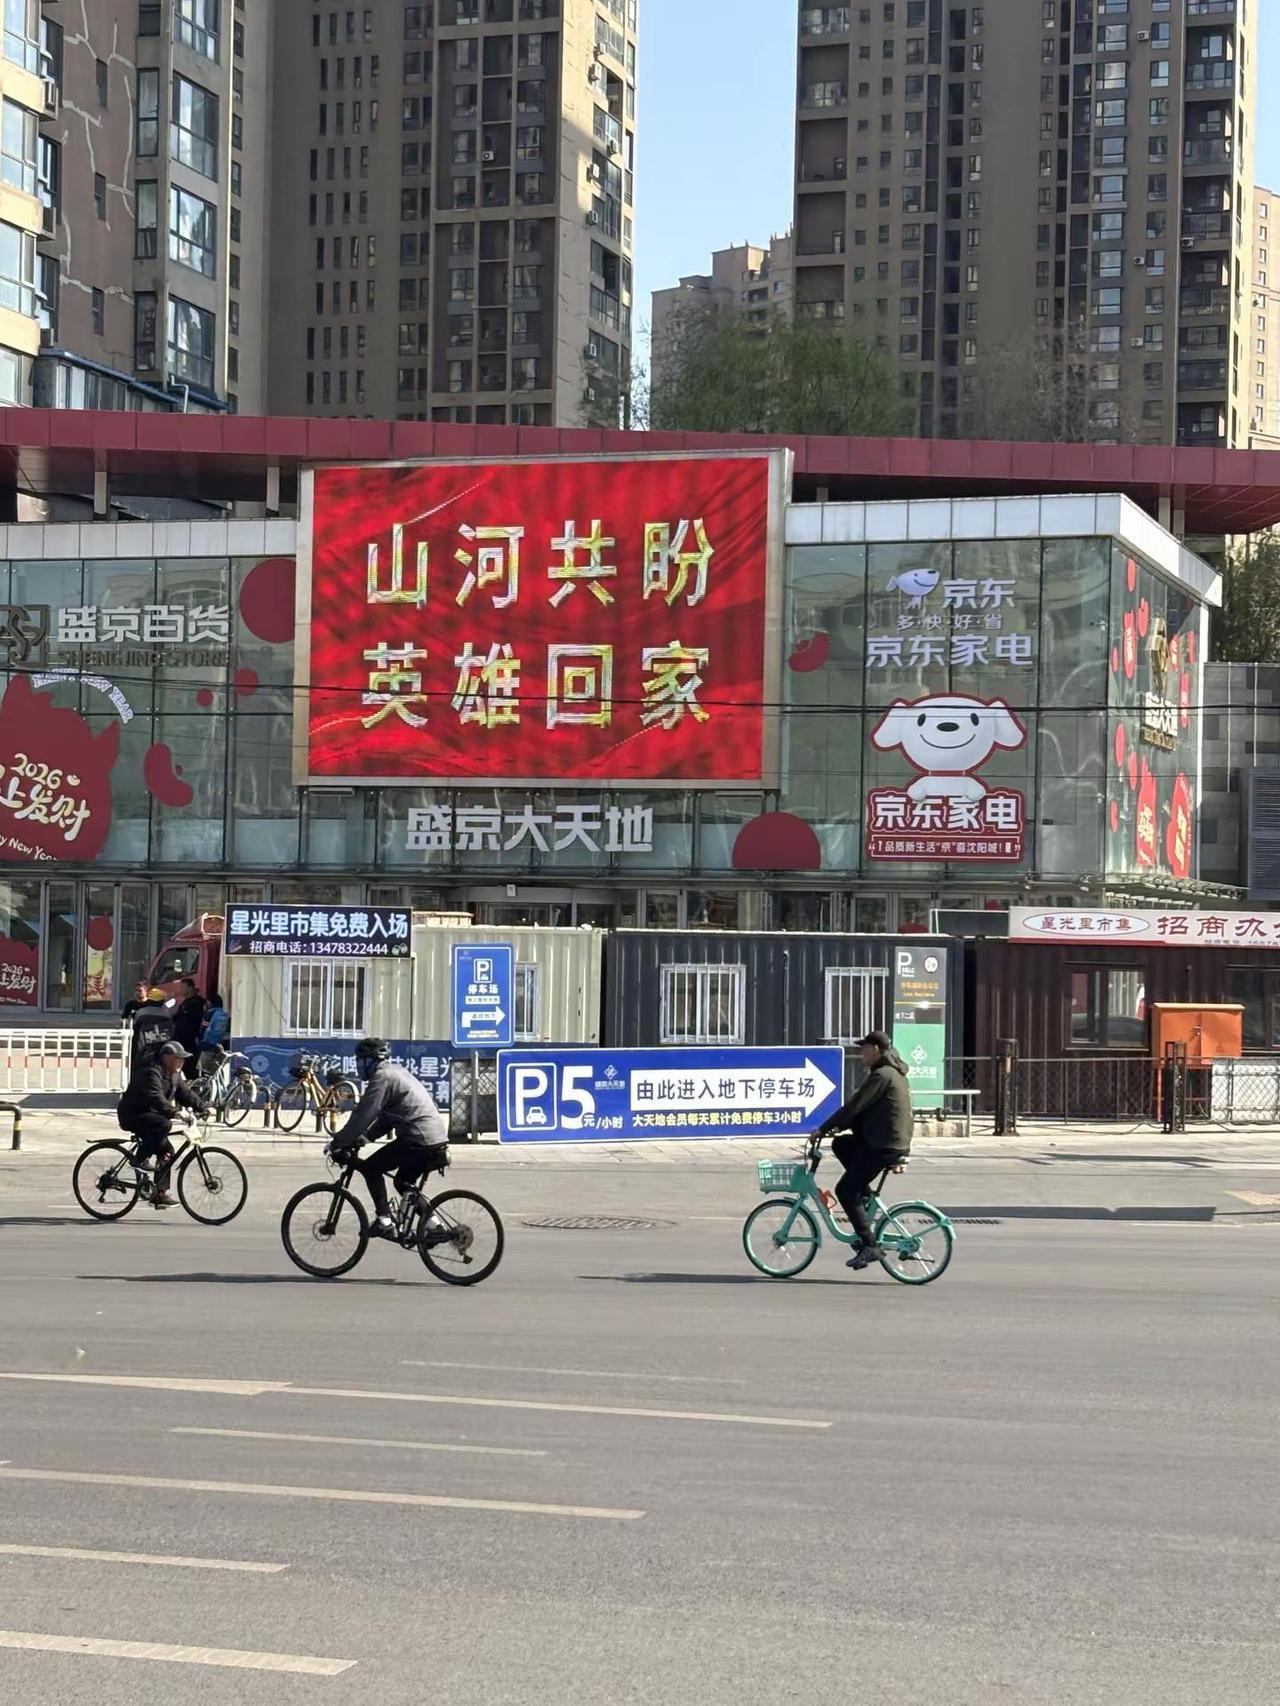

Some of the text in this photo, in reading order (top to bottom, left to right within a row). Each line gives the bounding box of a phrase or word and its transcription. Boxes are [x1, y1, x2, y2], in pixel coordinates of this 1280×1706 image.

[367, 518, 714, 608] 山河共盼
[942, 578, 1016, 609] 京东
[57, 605, 229, 643] 盛京百货
[865, 633, 1033, 668] 京东家电
[361, 639, 710, 730] 英雄回家
[10, 753, 63, 789] 2026
[0, 765, 91, 841] 上发财
[874, 796, 1018, 829] 京东家电
[9, 837, 33, 854] New
[405, 804, 654, 852] 盛京大天地
[230, 910, 409, 939] 星光里市集免费入场
[1041, 916, 1132, 931] 星光里市集
[467, 983, 499, 994] 停车场
[515, 1068, 548, 1125] P
[560, 1065, 596, 1130] 5
[636, 1077, 815, 1101] 由此进入地下停车场
[632, 1110, 802, 1128] 大天地会员每天累计免费停车3小时
